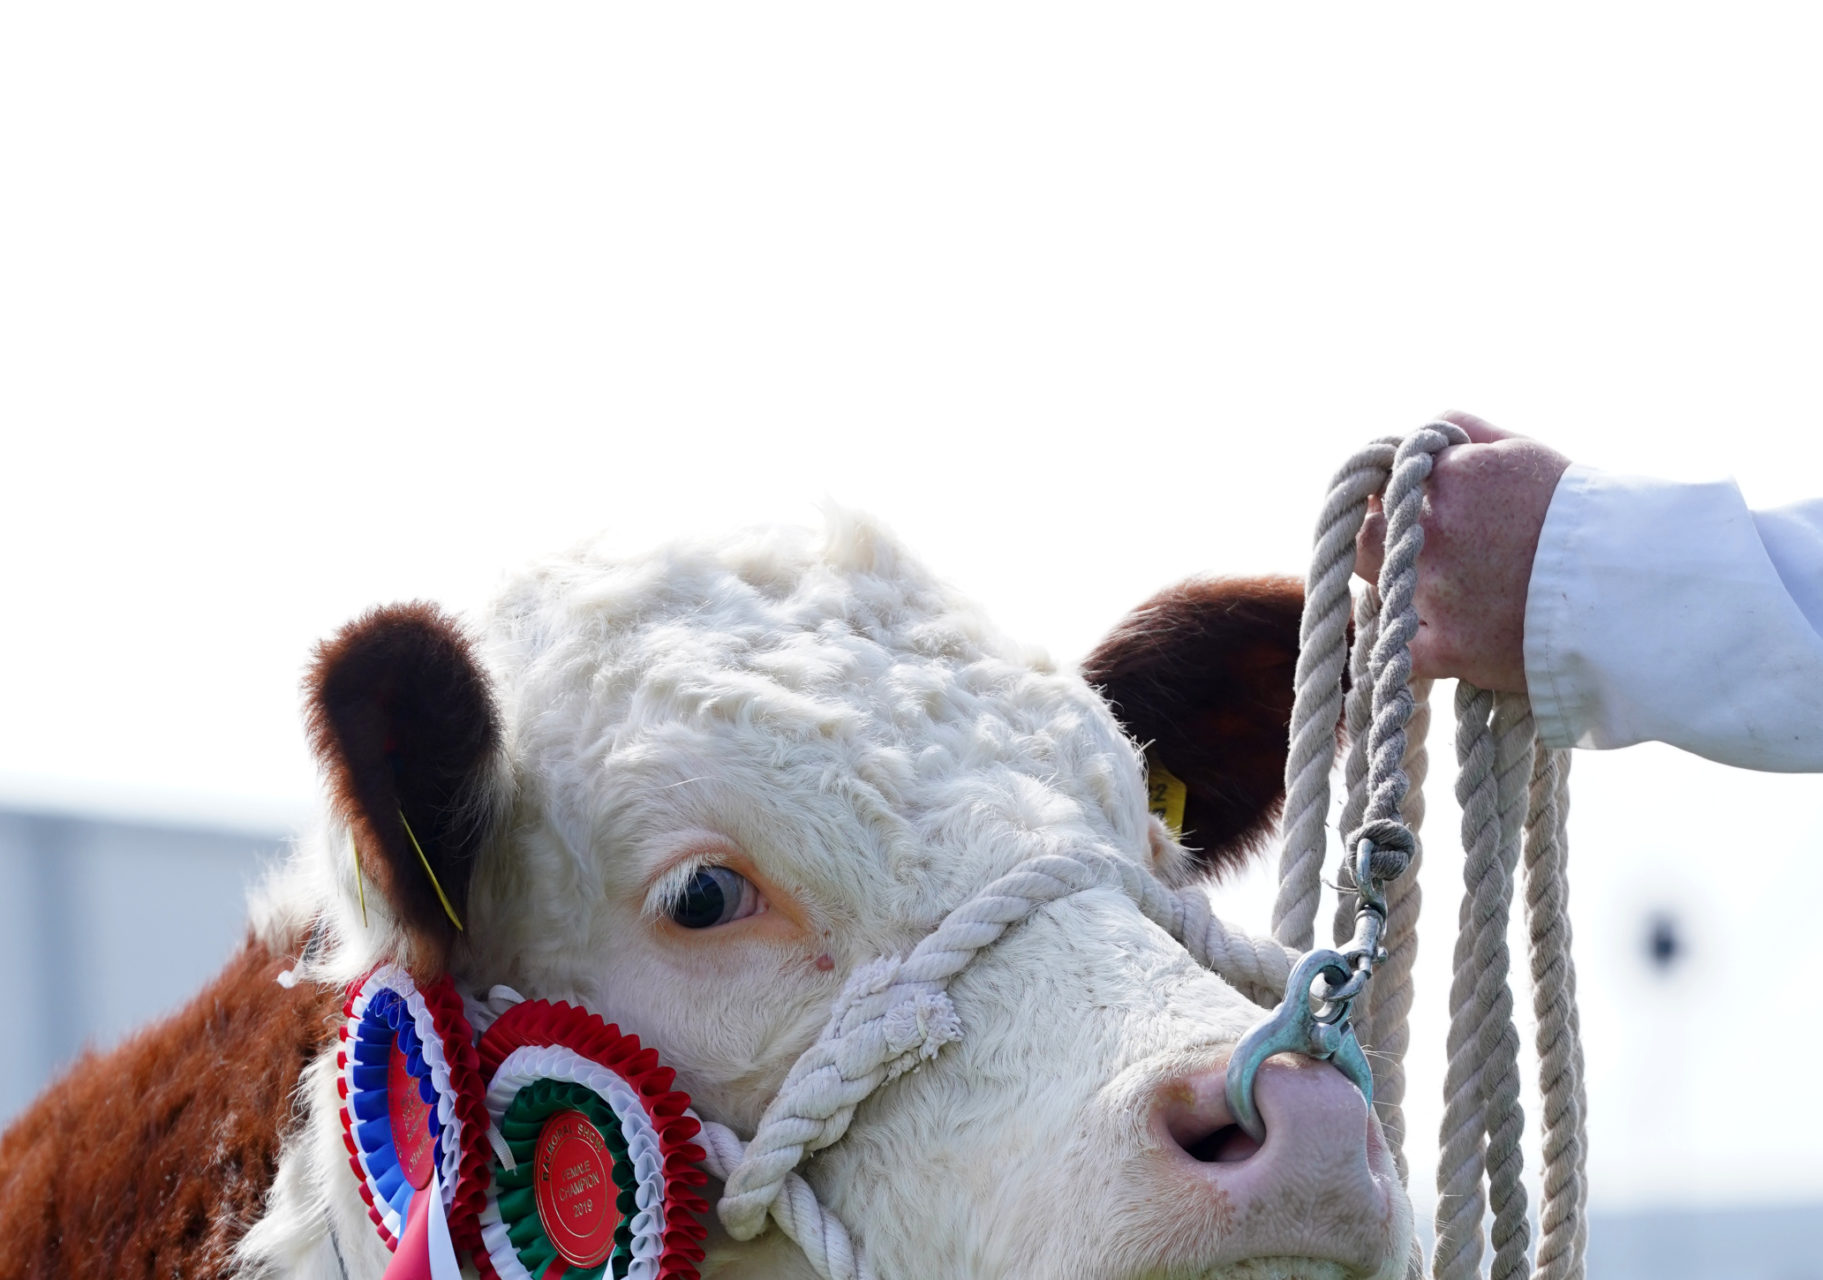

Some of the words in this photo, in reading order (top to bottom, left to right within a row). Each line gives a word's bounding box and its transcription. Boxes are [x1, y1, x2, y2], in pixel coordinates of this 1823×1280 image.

[542, 1123, 574, 1182] BALMORAL
[577, 1122, 604, 1153] SHOW
[561, 1159, 591, 1182] FEMALE
[559, 1171, 600, 1202] CHAMPION
[573, 1198, 593, 1218] 2019
